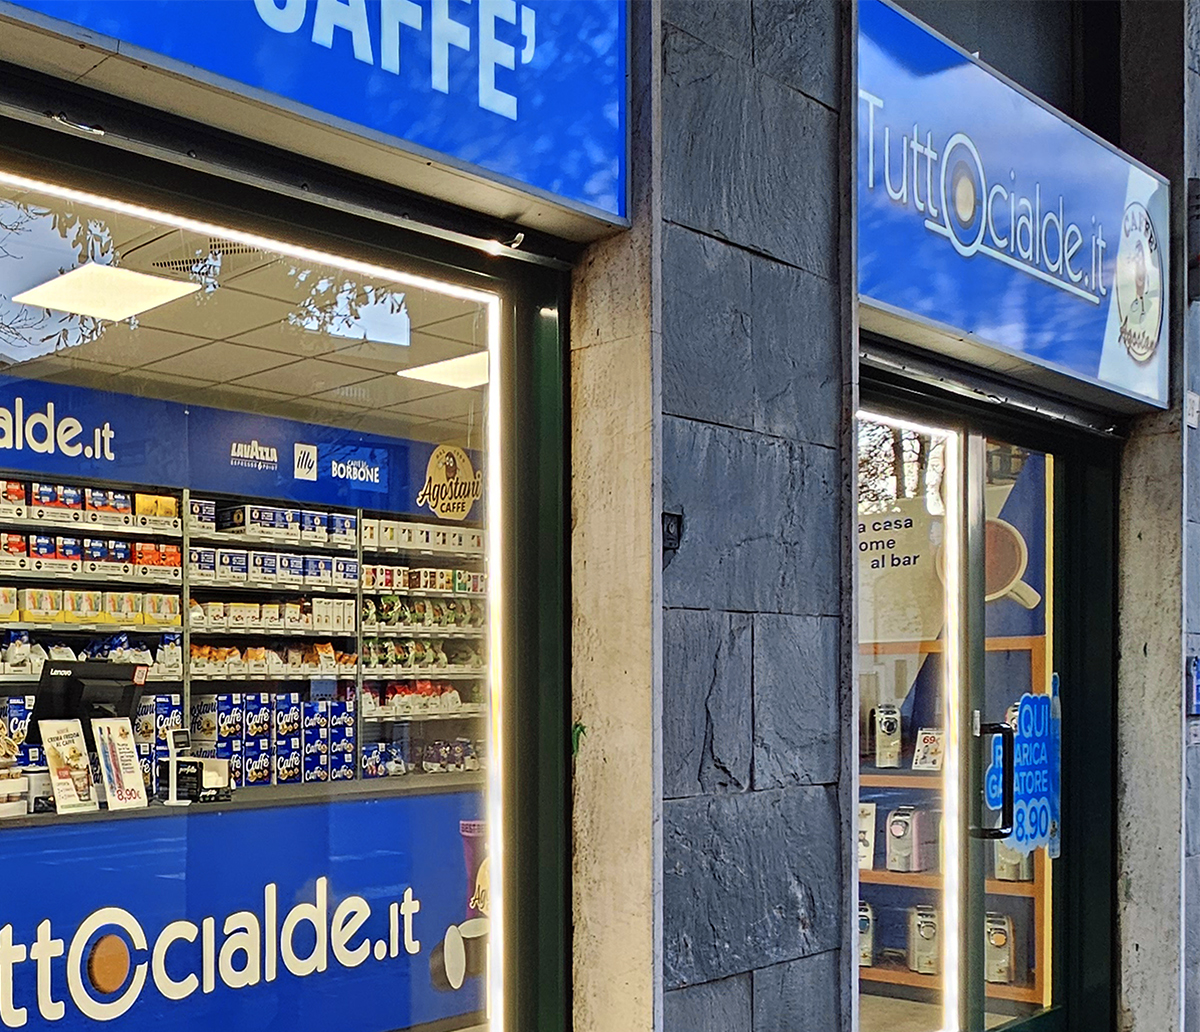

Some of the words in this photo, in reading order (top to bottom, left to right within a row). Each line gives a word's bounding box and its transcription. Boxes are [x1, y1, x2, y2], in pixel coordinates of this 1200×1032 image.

[230, 440, 278, 463] LAVAZZA
[296, 450, 315, 475] illy
[331, 460, 380, 483] BORBONE
[418, 473, 480, 509] Agostani
[858, 523, 866, 533] a
[872, 518, 913, 531] casa
[859, 539, 896, 551] ome
[870, 554, 885, 569] al
[890, 553, 920, 567] bar
[50, 668, 72, 676] Lenovo
[10, 711, 32, 733] Caf
[156, 709, 182, 729] Caffè
[219, 707, 242, 727] Caffè
[246, 706, 270, 726] Caffè
[277, 705, 300, 726] Caffè
[1020, 704, 1049, 738] QUI
[246, 752, 269, 772] Caffè
[277, 750, 300, 771] Caffè
[993, 742, 1048, 769] RARICA
[988, 769, 1048, 799] GAATORE
[116, 788, 142, 803] 8,90€
[1015, 804, 1049, 845] 8,90
